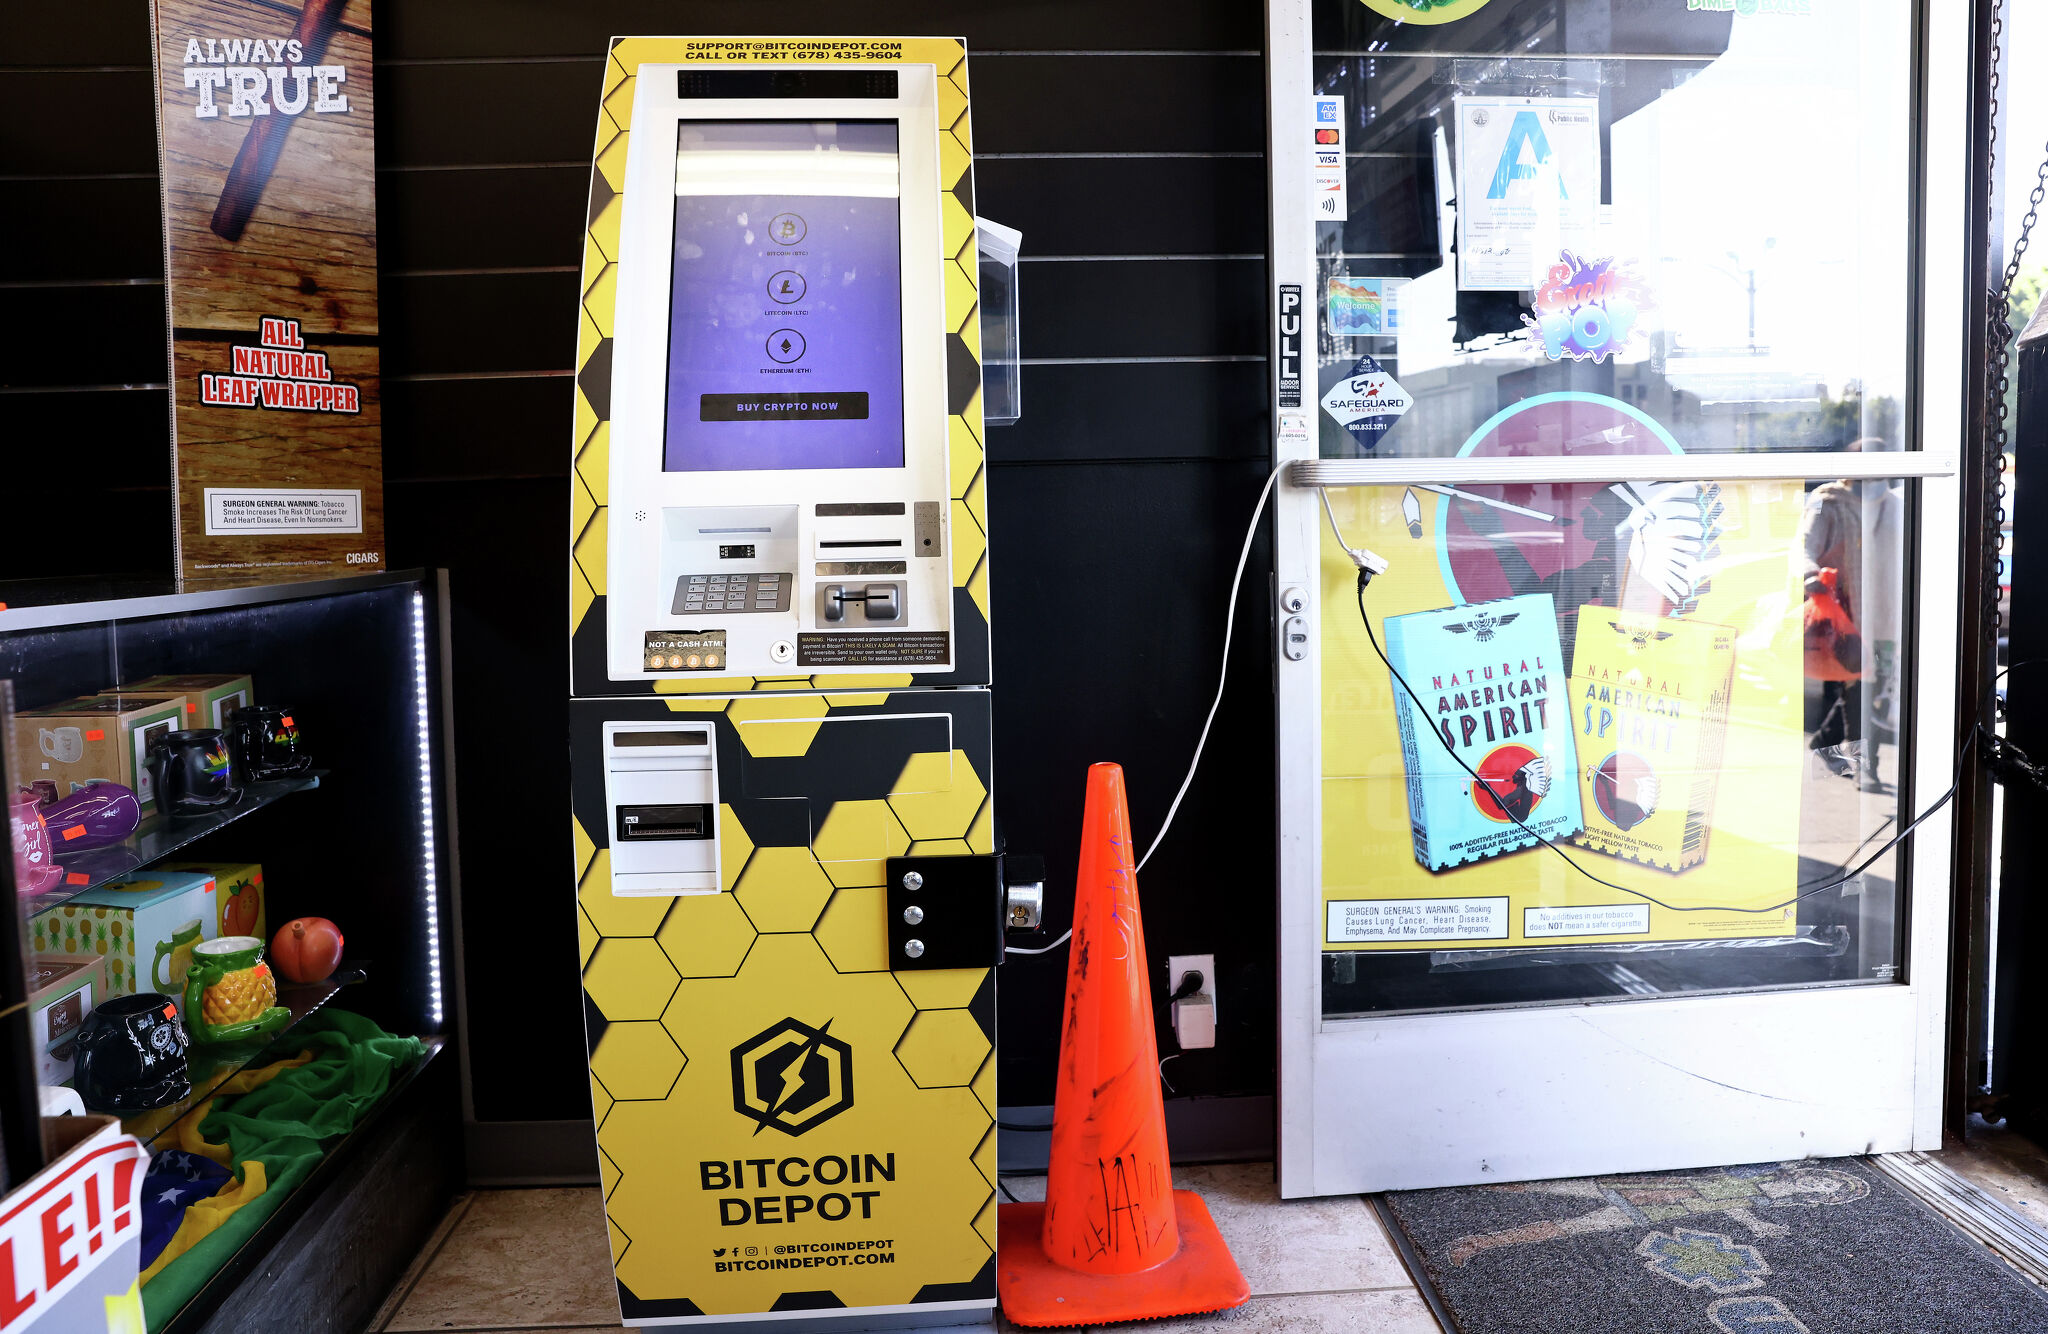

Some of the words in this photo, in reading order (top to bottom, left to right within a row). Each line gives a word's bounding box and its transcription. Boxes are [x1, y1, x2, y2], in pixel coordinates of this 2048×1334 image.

[184, 38, 303, 63] ALWAYS
[685, 52, 722, 60] CALL
[726, 52, 747, 60] OR
[752, 52, 788, 60] TEXT
[792, 51, 830, 60] (678)
[834, 51, 902, 60] 435-9604
[686, 42, 902, 50] SUPPORT@BITCOINDEPOT.COM
[1486, 111, 1569, 199] A
[1337, 301, 1376, 310] Welcome
[262, 319, 304, 349] ALL
[1281, 293, 1300, 378] PULL
[233, 346, 331, 381] NATURAL
[202, 374, 259, 408] LEAF
[260, 379, 359, 412] WRAPPER
[1330, 400, 1404, 408] SAFEGUARD
[736, 403, 760, 412] BUY
[764, 402, 808, 411] CRYPTO
[812, 402, 838, 410] NOW
[312, 508, 326, 516] Lung
[346, 552, 379, 564] CIGARS
[1432, 657, 1544, 690] NATURAL
[1438, 675, 1548, 714] AMERICAN
[1584, 683, 1681, 718] AMERICAN
[1440, 697, 1550, 751] SPIRIT
[1584, 702, 1678, 753] SPIRIT
[1464, 830, 1508, 848] ADDITIVE-FREE
[1538, 816, 1568, 828] TOBACCO
[1467, 842, 1497, 854] REGULAR
[1538, 826, 1555, 836] TASTE
[1584, 833, 1600, 842] LIGHT
[1601, 838, 1623, 847] MELLOW
[1624, 843, 1639, 852] TASTE
[1614, 832, 1637, 845] NATURAL
[1638, 840, 1663, 852] TOBACCO
[1345, 907, 1380, 916] SURGEON
[1383, 906, 1422, 915] GENERAL'S
[1464, 905, 1492, 914] Smoking
[1345, 917, 1372, 926] Causes
[1375, 917, 1394, 926] Lung
[1433, 916, 1455, 924] Heart
[1459, 915, 1491, 924] Disease,
[1345, 927, 1385, 936] Emphysema,
[1387, 926, 1401, 935] And
[1403, 926, 1417, 935] May
[1420, 926, 1454, 935] Complicate
[700, 1152, 896, 1190] BITCOIN
[718, 1190, 880, 1226] DEPOT
[0, 1157, 138, 1332] LE!!
[774, 1240, 894, 1255] @BITCOINDEPOT
[715, 1252, 895, 1272] BITCOINDEPOT.COM
